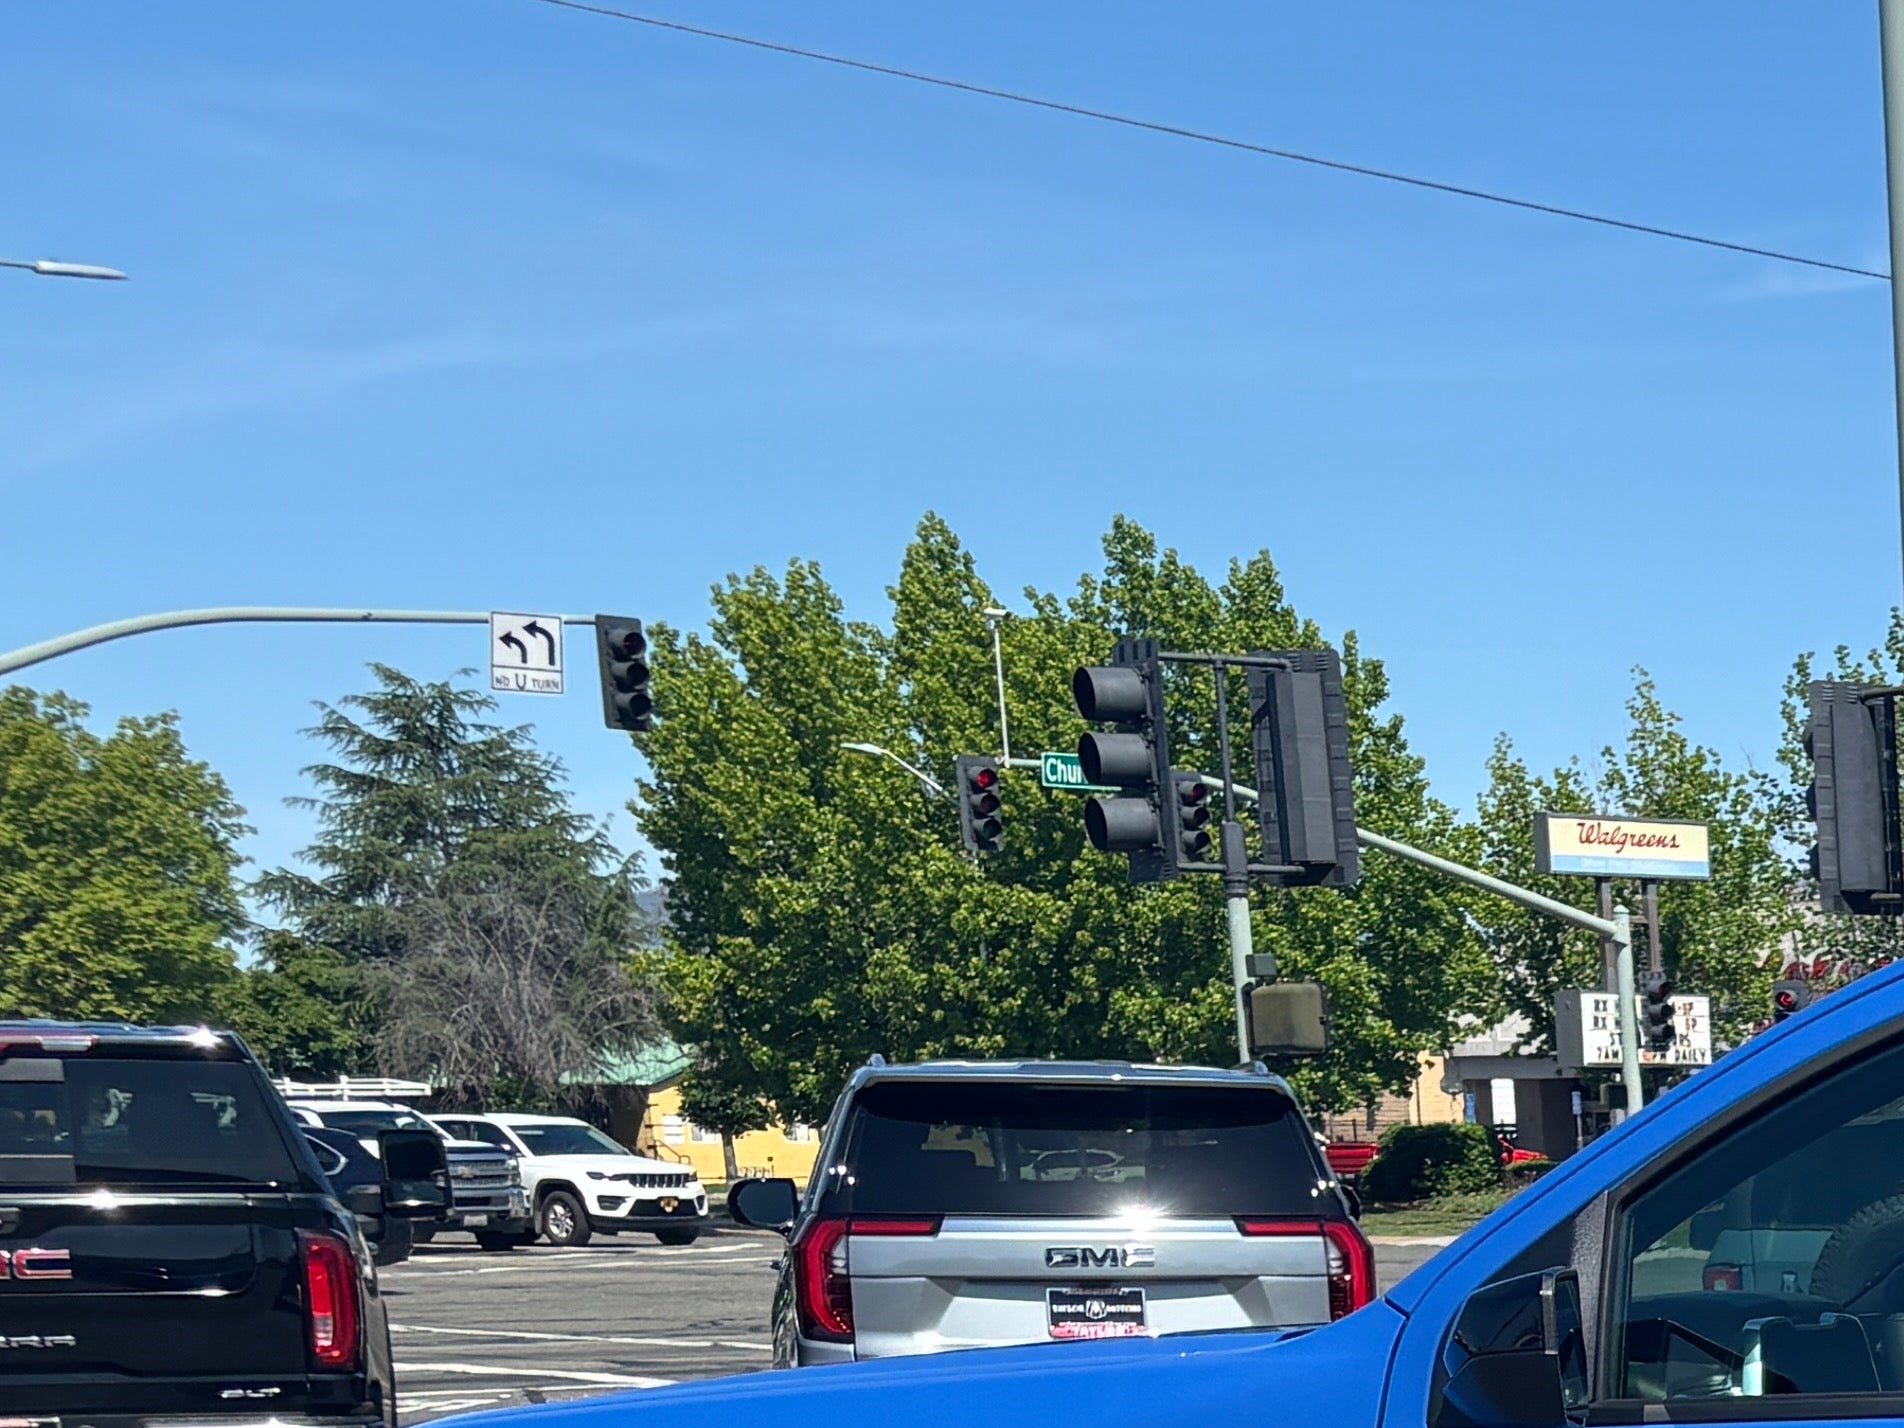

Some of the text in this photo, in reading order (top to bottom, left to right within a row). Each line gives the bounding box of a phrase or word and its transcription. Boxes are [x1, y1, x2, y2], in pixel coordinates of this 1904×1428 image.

[495, 672, 560, 691] NO U TURN
[1577, 822, 1680, 854] Walgreens
[1675, 1049, 1706, 1062] DAILY
[1045, 1246, 1155, 1268] GMC
